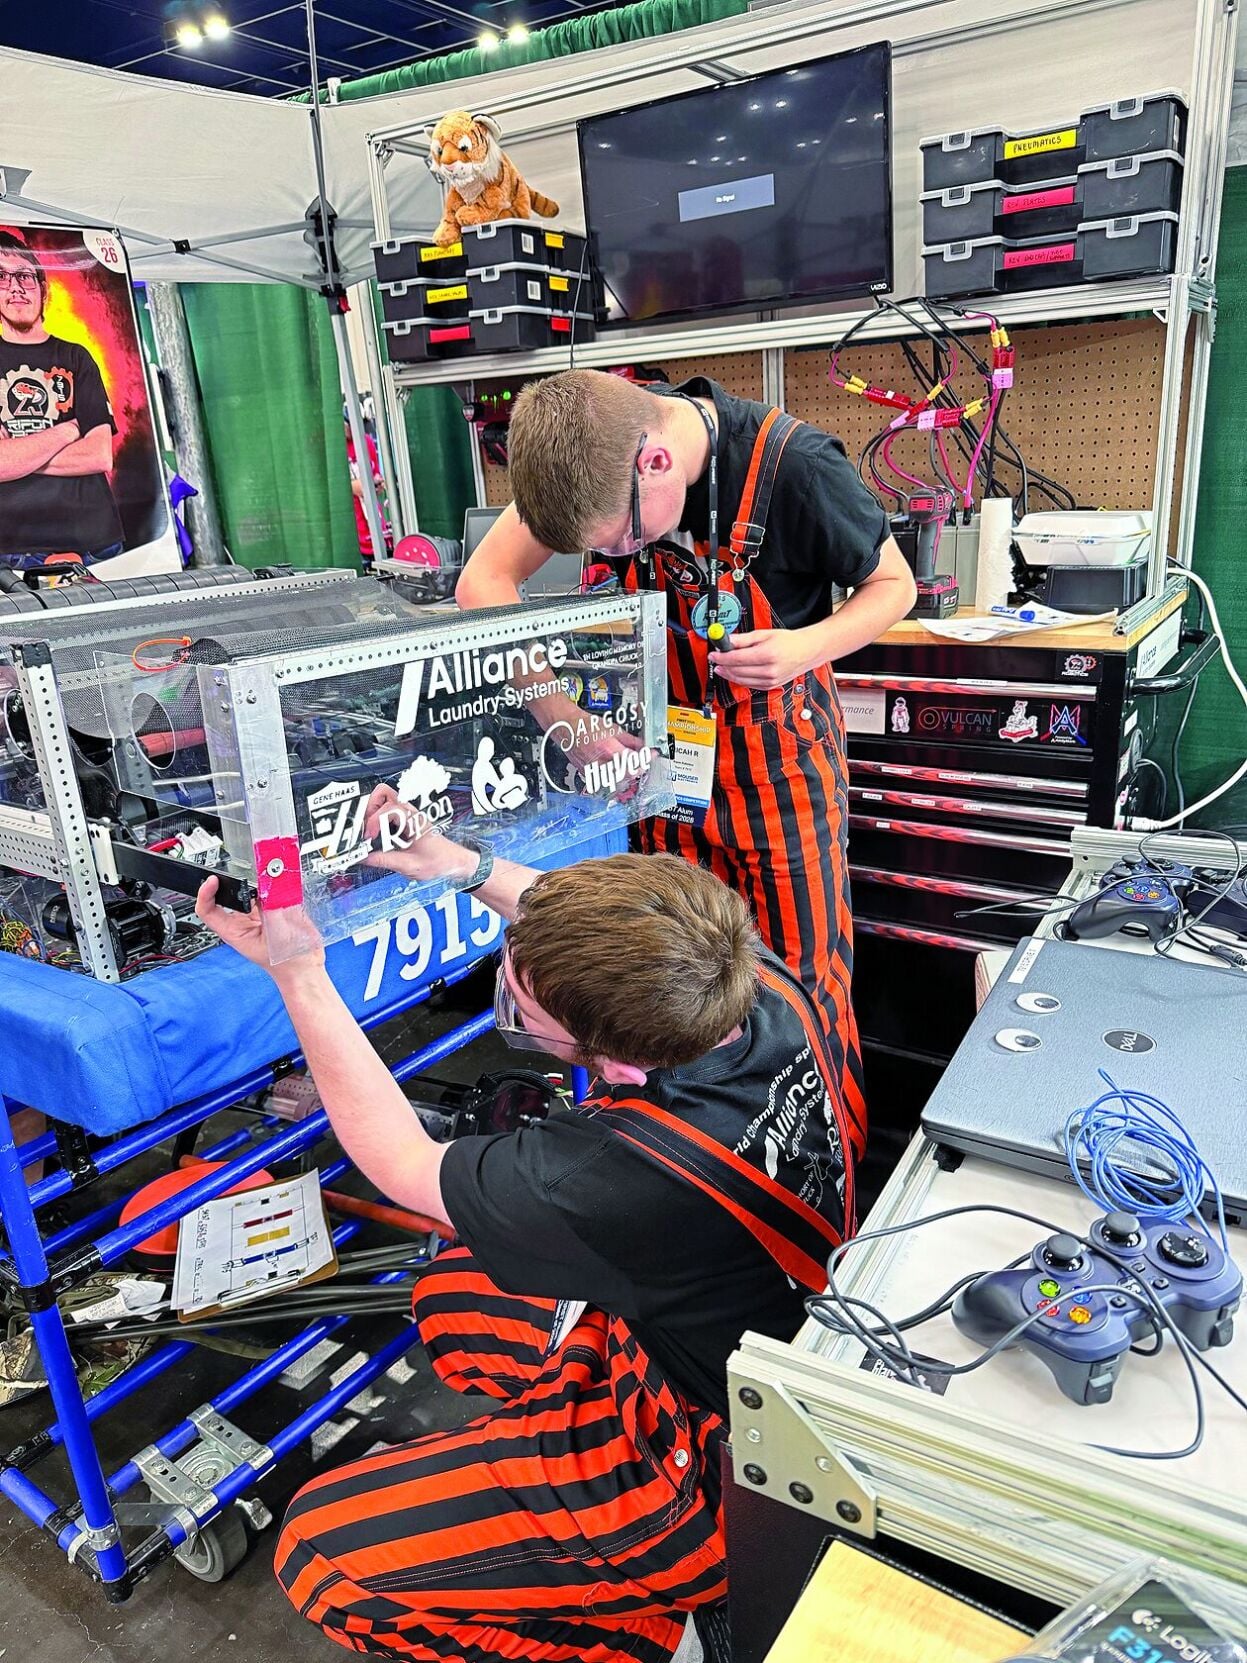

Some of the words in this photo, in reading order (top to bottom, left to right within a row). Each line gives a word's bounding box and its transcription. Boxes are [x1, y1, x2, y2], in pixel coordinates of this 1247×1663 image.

[1013, 136, 1062, 153] PNEUMATICS
[95, 237, 115, 246] CLASS
[101, 247, 118, 263] 26
[591, 646, 613, 660] LOVING
[613, 642, 637, 655] MEMORY
[427, 638, 568, 700] Alliance
[428, 695, 500, 728] Laundry
[504, 677, 570, 708] Systems
[576, 701, 649, 736] ARGOSY
[941, 712, 993, 726] VULCAN
[942, 724, 992, 733] SPRING
[576, 720, 650, 748] FOUNDATION
[313, 793, 333, 804] GENE
[334, 785, 355, 797] HAAS
[379, 795, 454, 853] Ripon
[351, 888, 502, 1003] 7915
[1120, 1032, 1138, 1051] DELL
[746, 1063, 794, 1138] Championship
[767, 1070, 818, 1151] Allianc
[1107, 1624, 1175, 1663] F31
